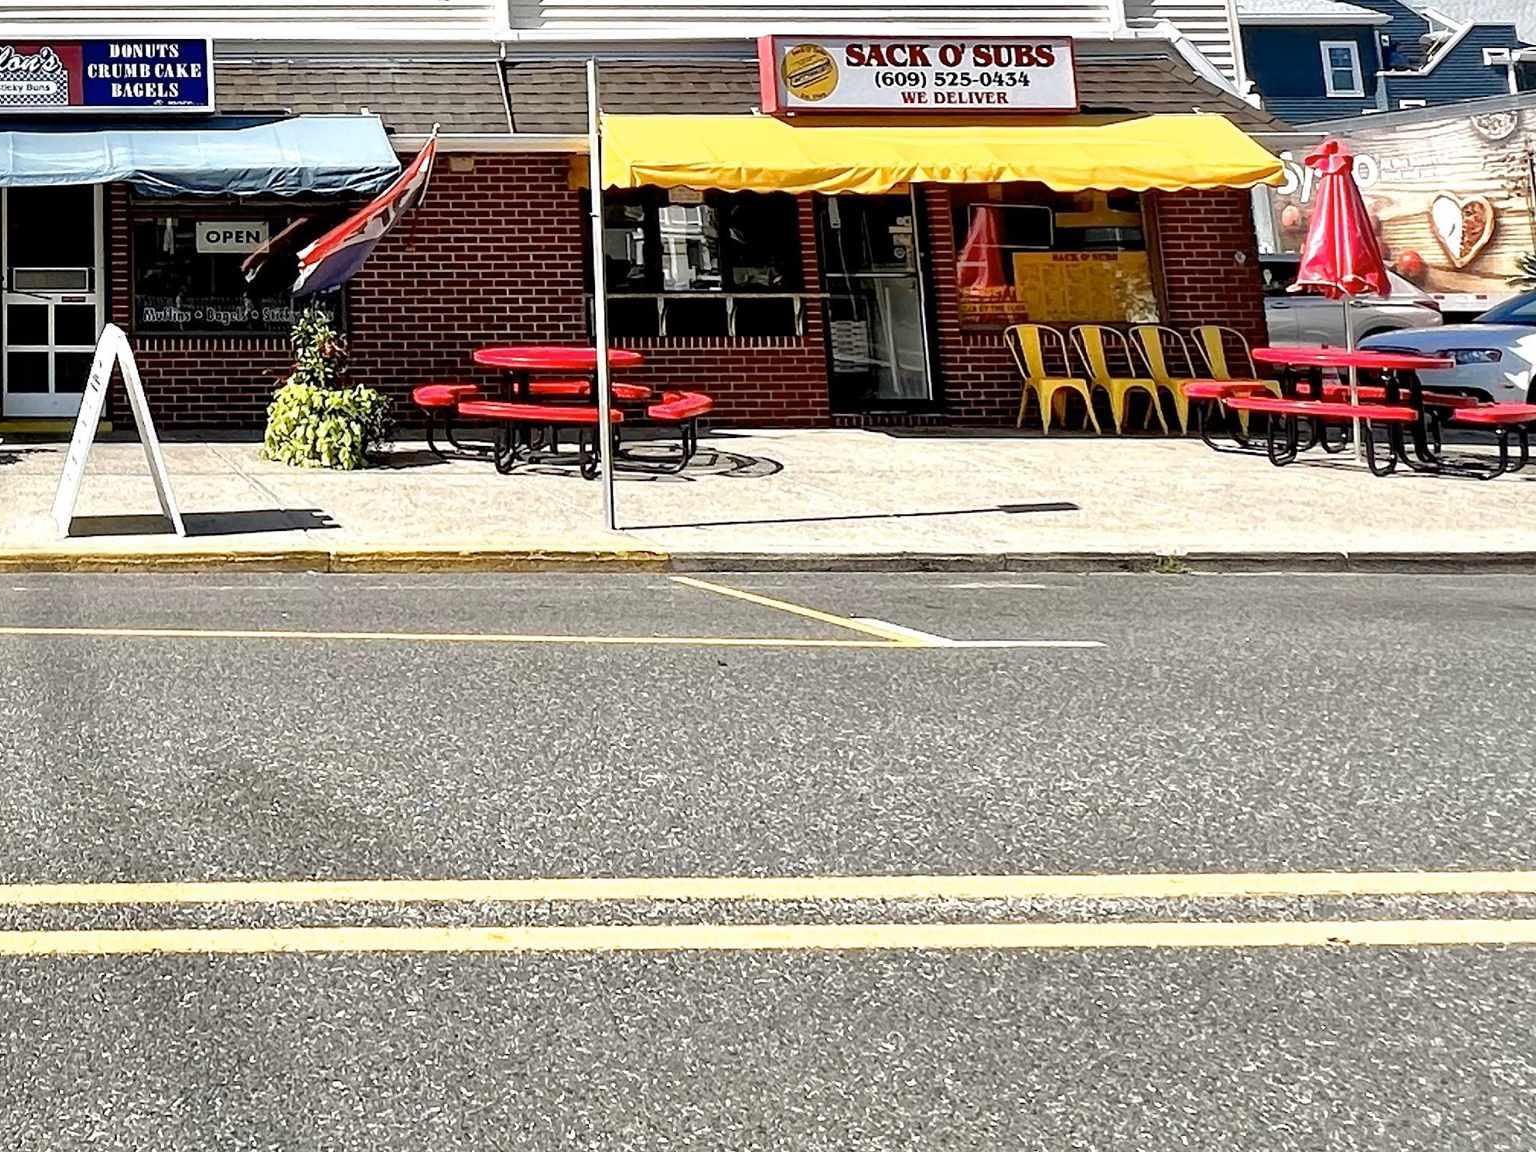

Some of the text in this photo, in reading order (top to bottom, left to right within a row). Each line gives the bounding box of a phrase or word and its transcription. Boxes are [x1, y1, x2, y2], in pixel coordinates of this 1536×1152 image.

[109, 43, 179, 58] DONUTS
[845, 44, 932, 68] SACK
[938, 44, 965, 67] O'
[972, 44, 1055, 68] SUBS
[87, 63, 202, 78] CRUMB CAKE
[26, 83, 50, 91] Buns
[874, 71, 1031, 88] (609) 525-0434
[111, 83, 179, 98] BAGELS
[901, 91, 1009, 104] WE DELIVER
[1277, 150, 1379, 203] Syo
[206, 230, 261, 244] OPEN
[143, 306, 191, 322] Muffins
[206, 306, 247, 326] Bagels
